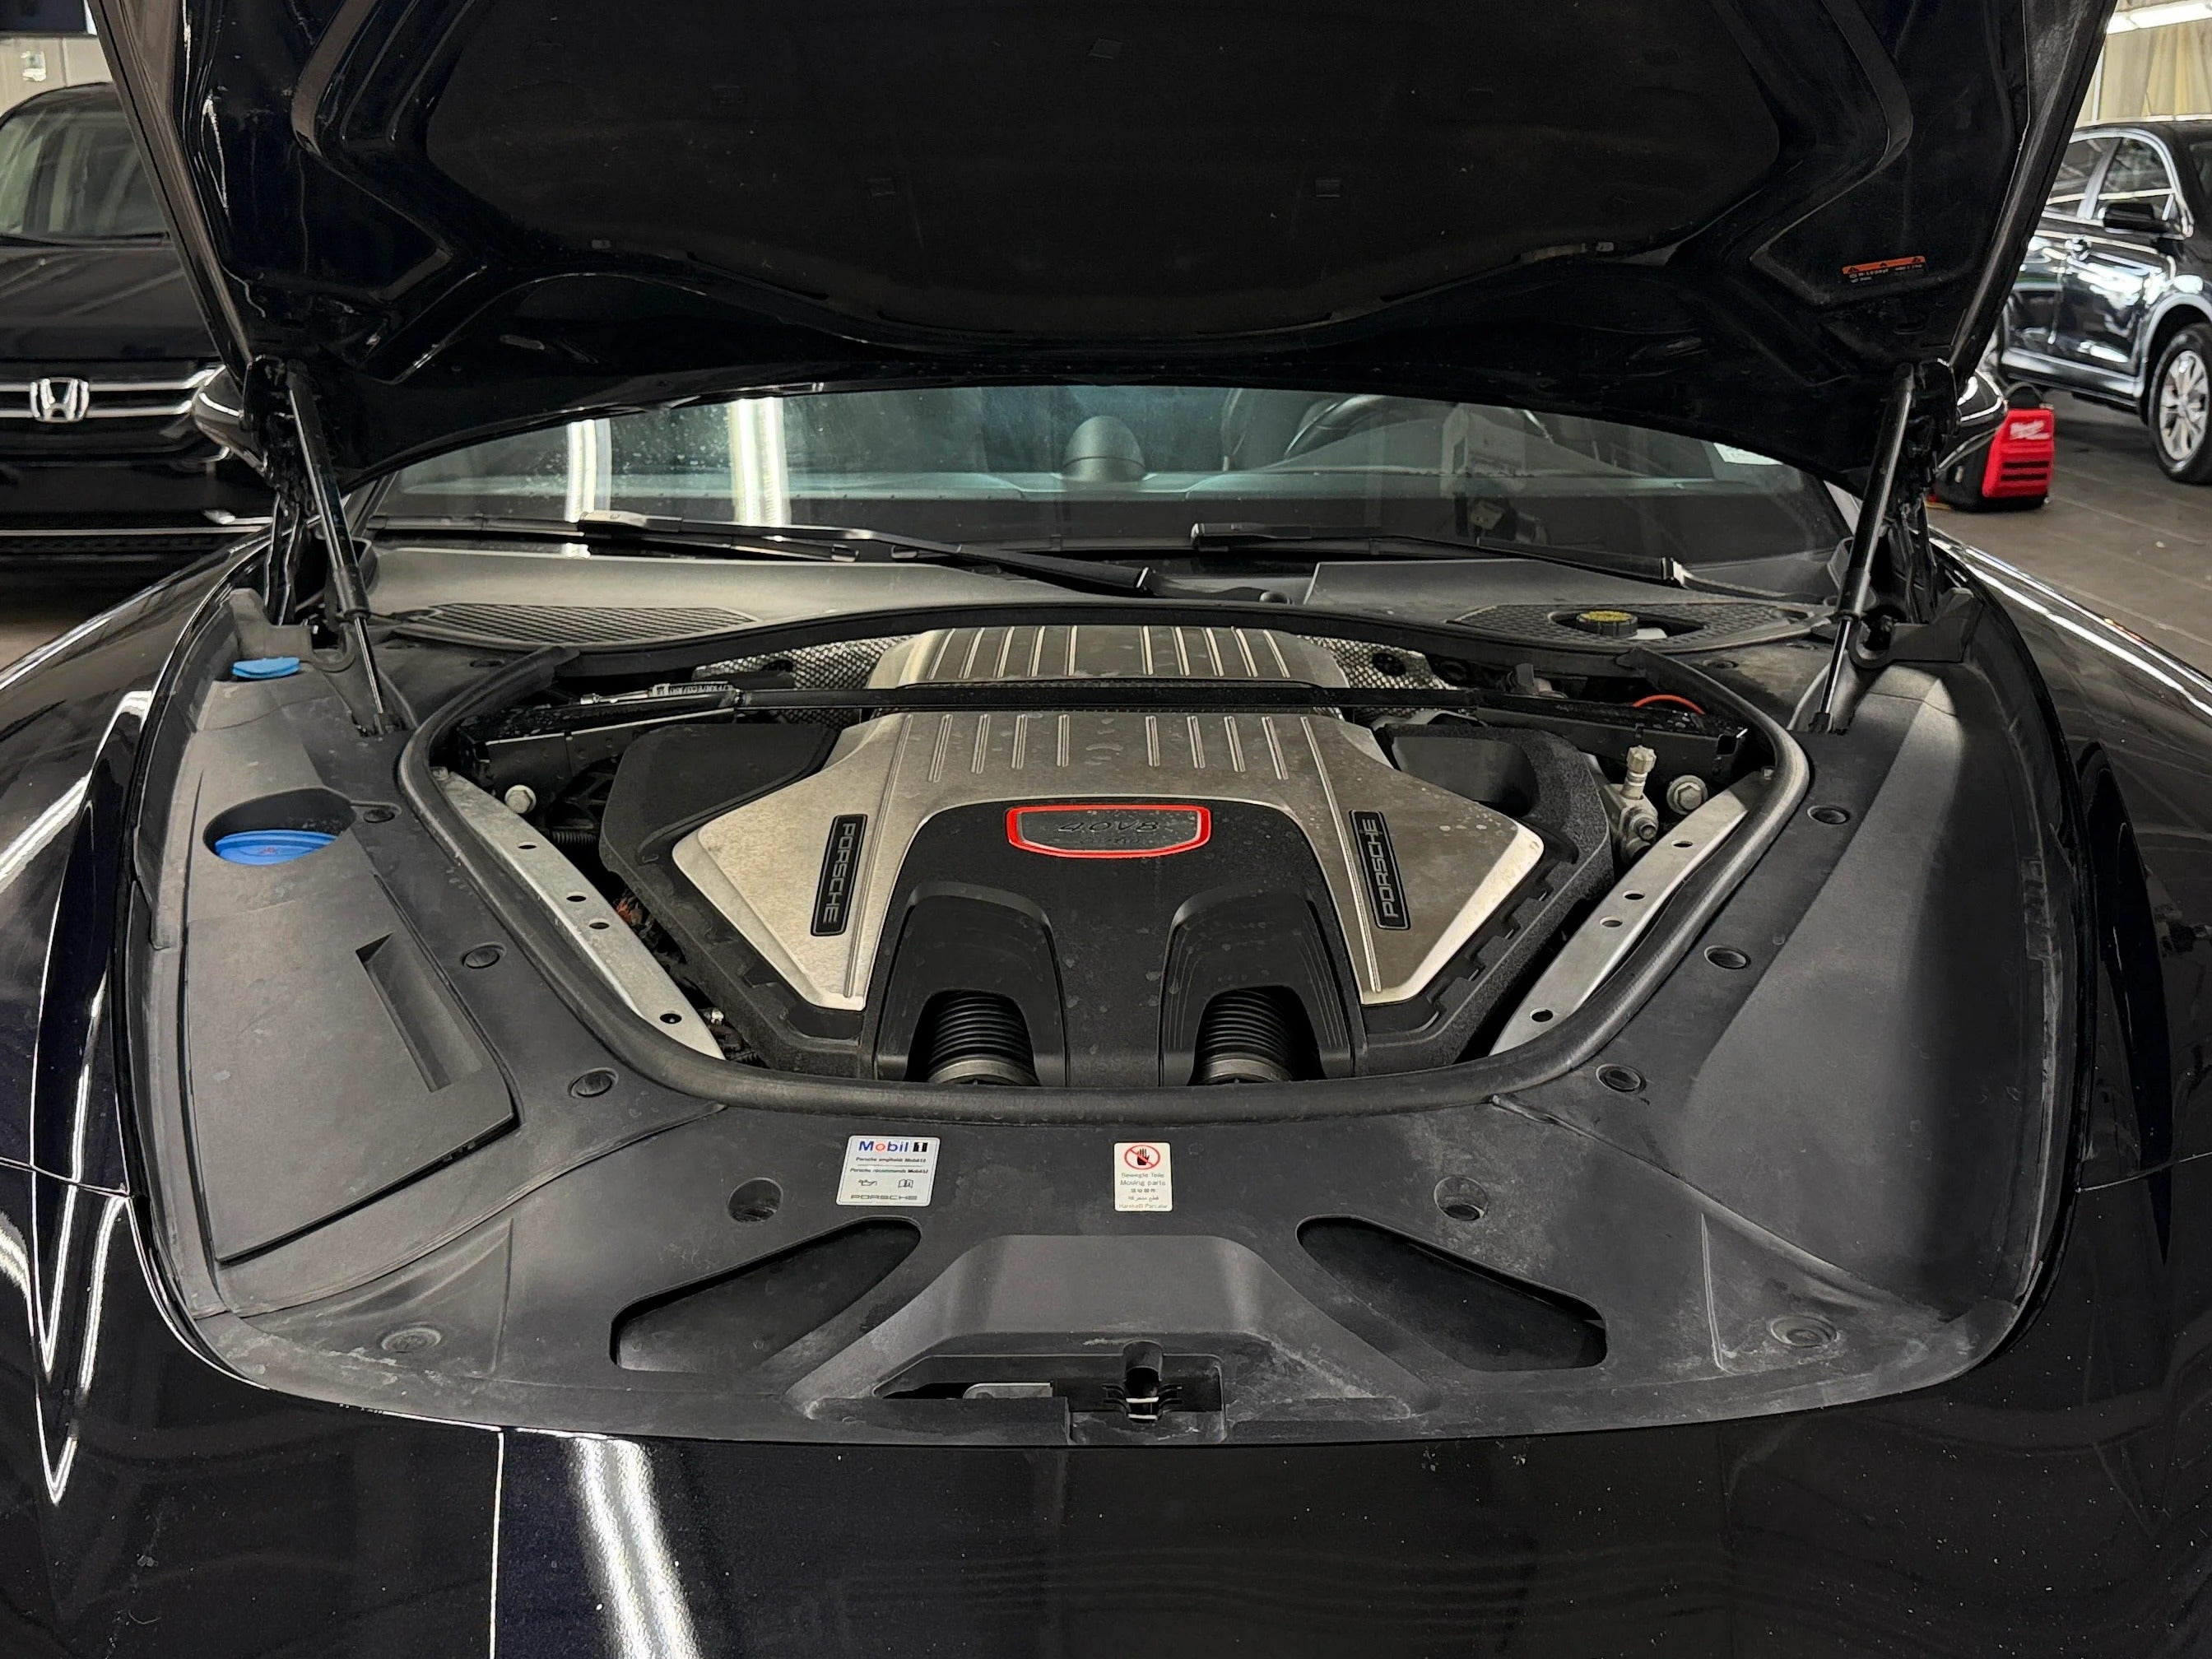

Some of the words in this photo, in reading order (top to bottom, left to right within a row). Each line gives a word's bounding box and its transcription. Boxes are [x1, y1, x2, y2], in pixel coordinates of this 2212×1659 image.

[823, 823, 857, 923] PORSCHE
[1361, 819, 1399, 918] PORSCHE
[858, 1141, 909, 1152] Mobil
